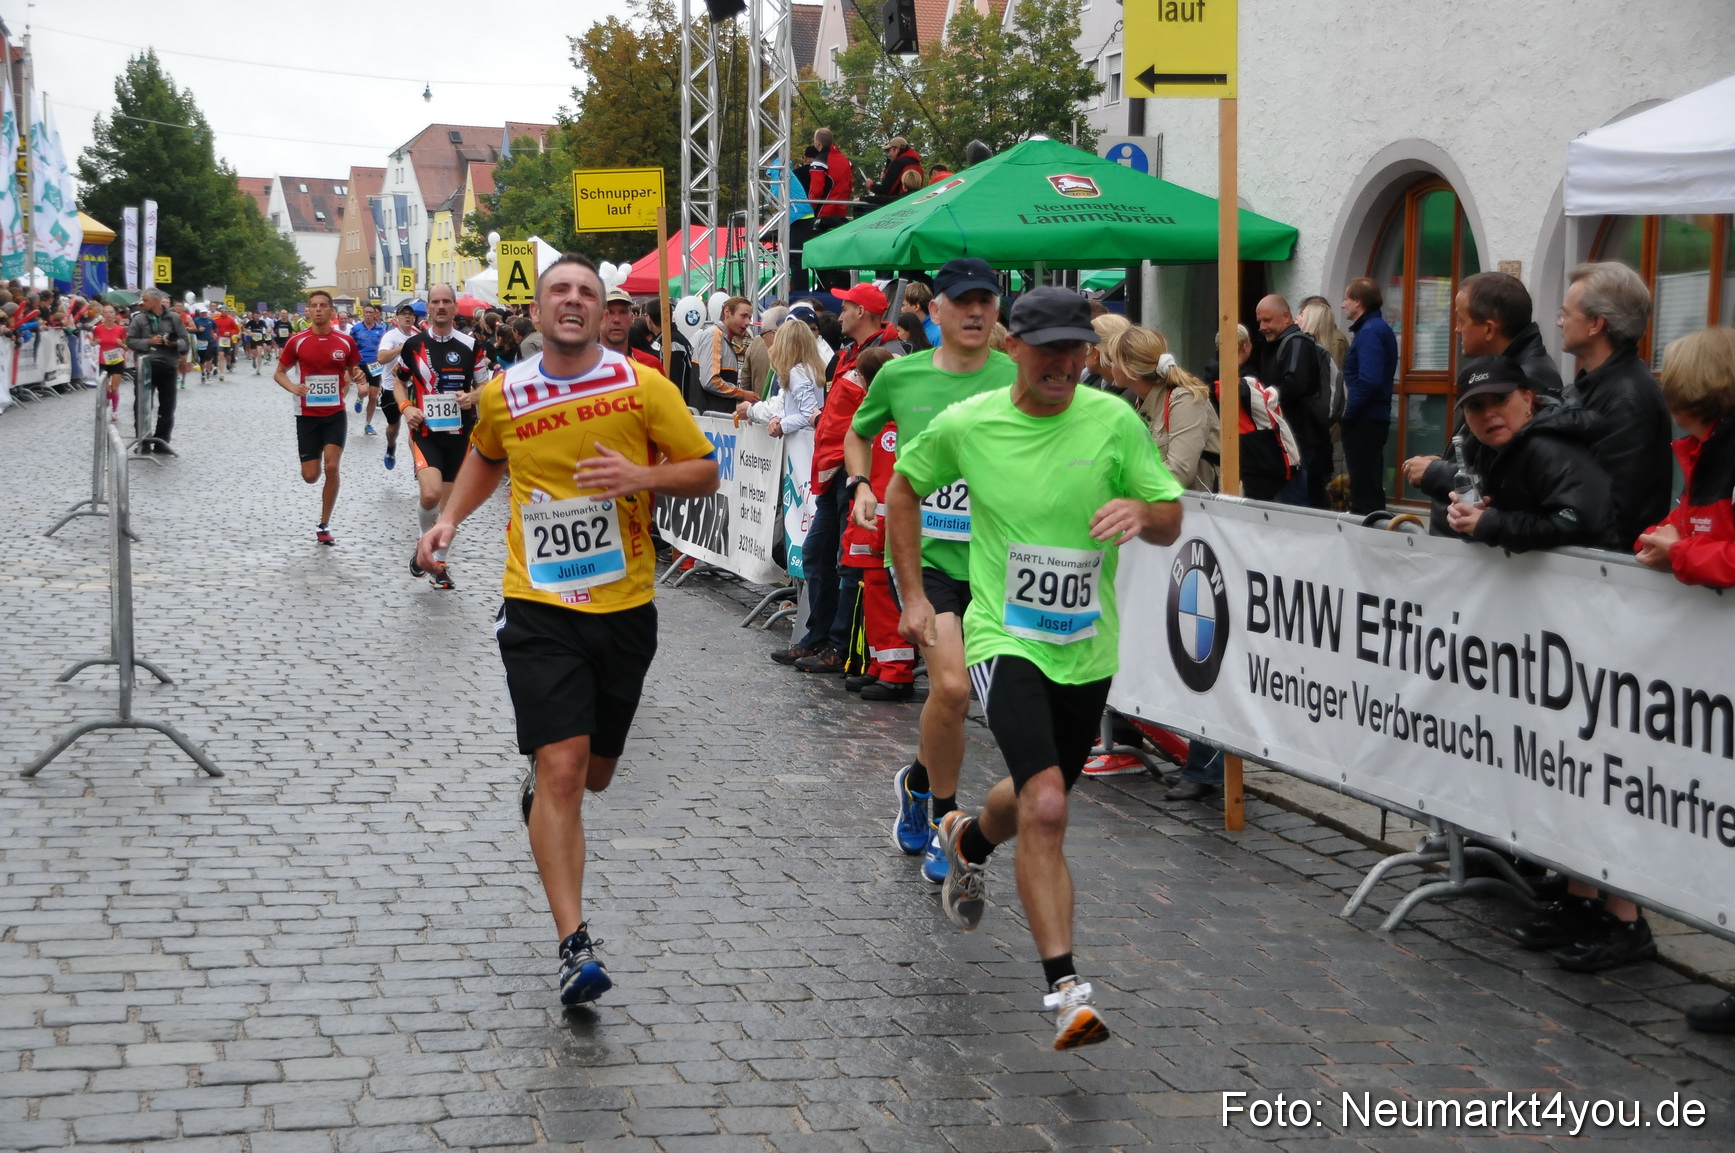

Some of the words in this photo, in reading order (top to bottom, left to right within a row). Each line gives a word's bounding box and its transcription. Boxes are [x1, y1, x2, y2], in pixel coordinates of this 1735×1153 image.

[1158, 0, 1206, 23] lauf
[580, 187, 657, 201] Schnupper-
[607, 203, 632, 216] lauf
[1033, 202, 1146, 213] Neumarkter
[1017, 211, 1177, 226] Lammsbräu
[501, 244, 534, 256] Block
[157, 264, 167, 278] B
[506, 260, 531, 291] A
[402, 275, 412, 288] B
[309, 382, 337, 395] 2555
[427, 402, 458, 418] 3184
[515, 411, 571, 442] MAX
[576, 395, 644, 422] BÖGL
[523, 511, 551, 522] PARTL
[552, 504, 598, 518] Neumarkt
[534, 516, 612, 558] 2962
[1009, 551, 1044, 565] PARTL
[1047, 556, 1092, 569] Neumarkt
[558, 562, 596, 579] Julian
[1172, 543, 1224, 596] BMW
[1016, 568, 1092, 608] 2905
[1036, 614, 1073, 632] Josef
[1246, 569, 1344, 653] BMW
[1356, 591, 1735, 760] EfficientDynam
[1247, 652, 1347, 723] Weniger
[1351, 680, 1503, 769] Verbrauch.
[1513, 724, 1592, 799] Mehr
[1602, 752, 1735, 848] Fahrfre
